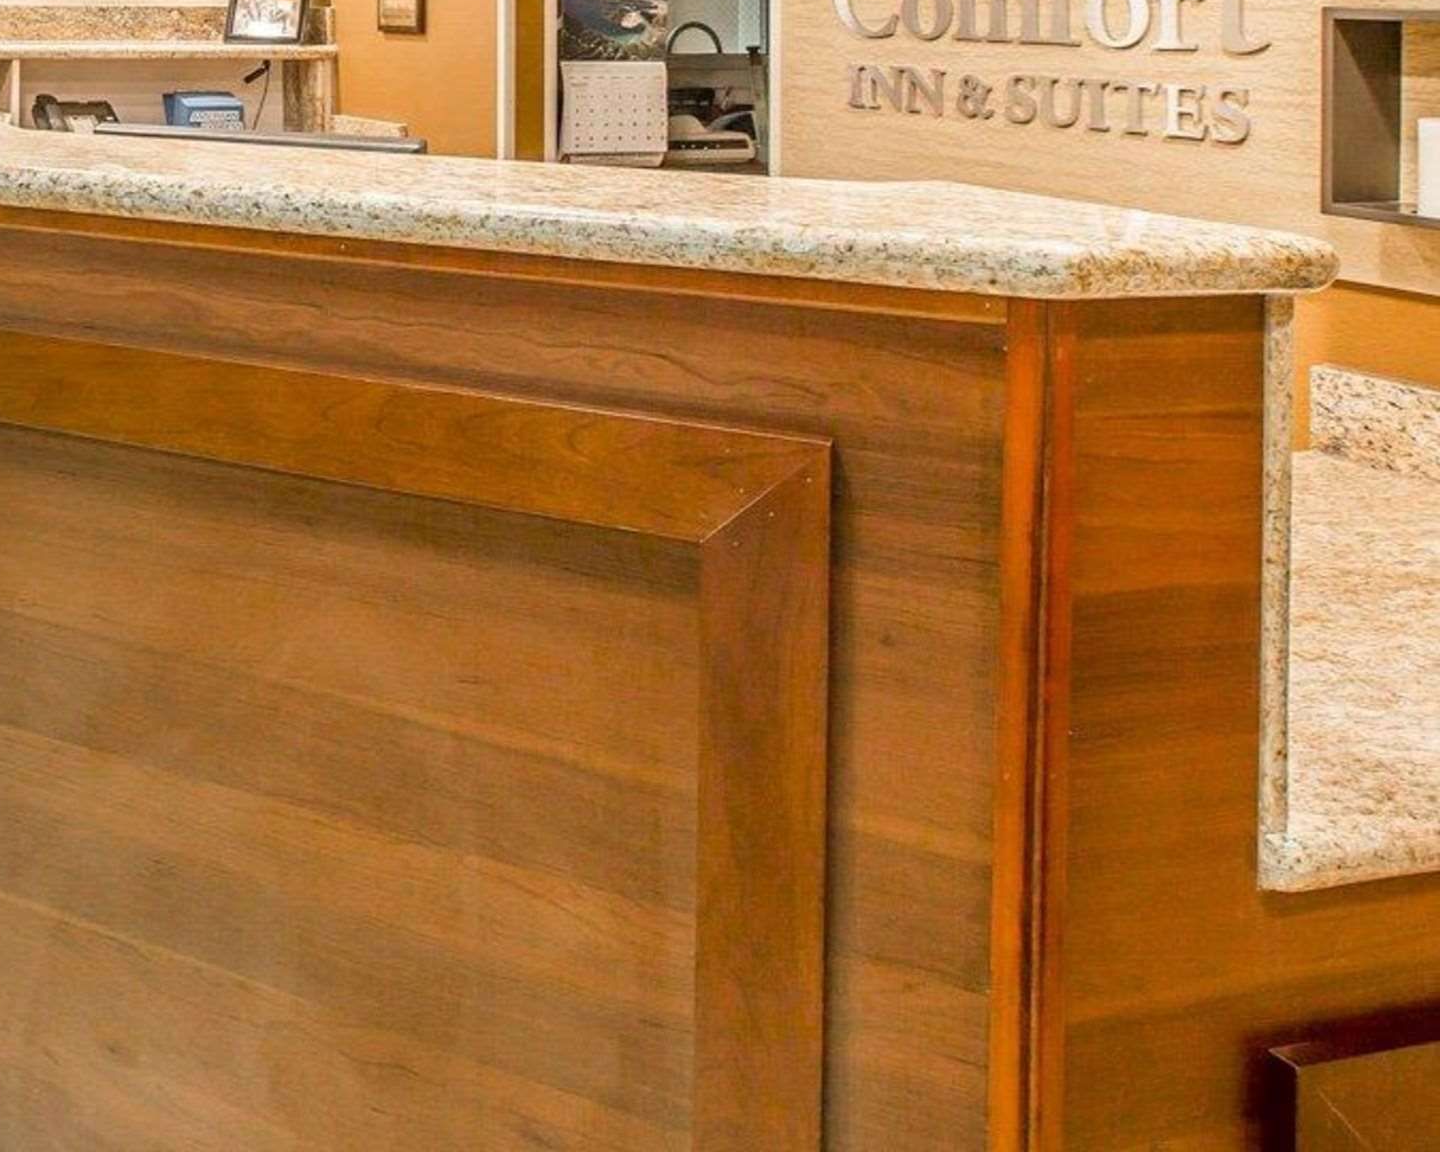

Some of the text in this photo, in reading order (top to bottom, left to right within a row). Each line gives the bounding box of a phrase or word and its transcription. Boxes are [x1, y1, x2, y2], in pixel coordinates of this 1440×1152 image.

[847, 64, 1252, 146] INN & SUITES
